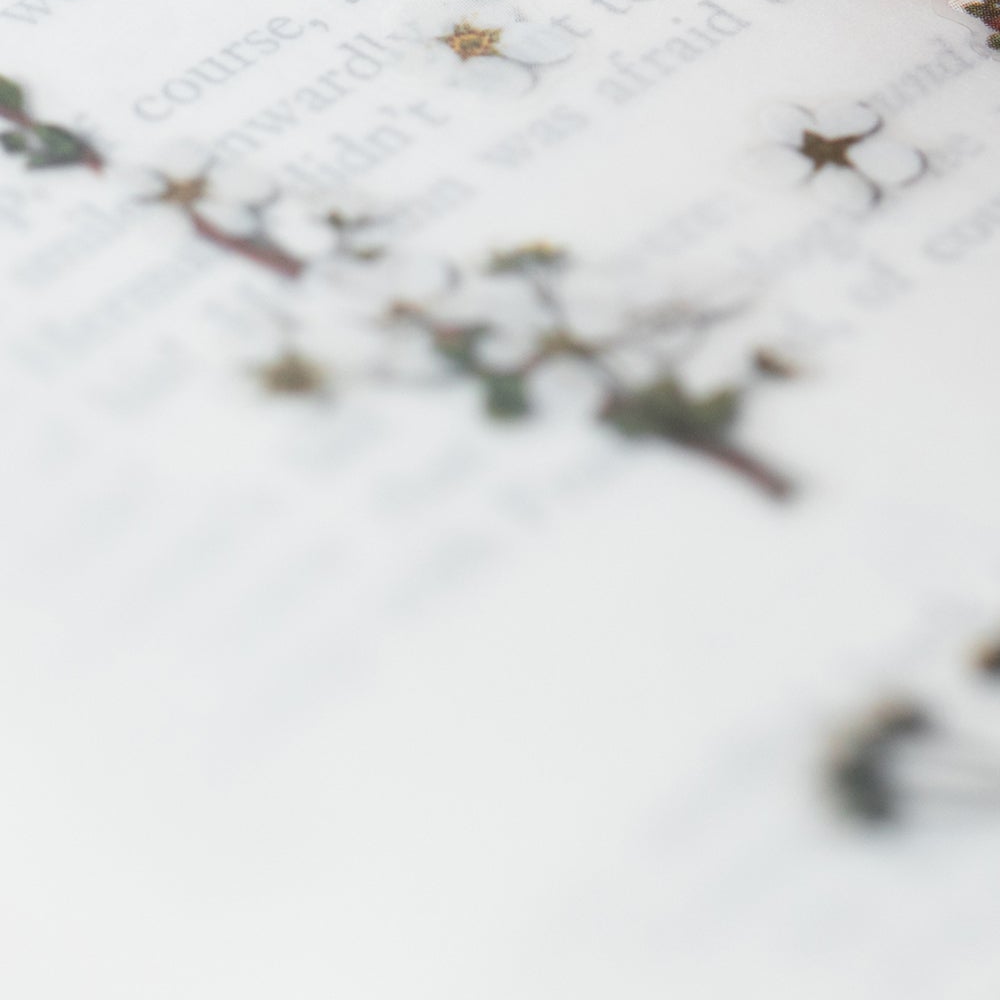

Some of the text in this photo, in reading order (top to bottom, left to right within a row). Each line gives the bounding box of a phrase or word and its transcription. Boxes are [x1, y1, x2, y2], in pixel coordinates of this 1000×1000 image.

[133, 15, 331, 121] course,
[212, 18, 437, 162] nwardly
[474, 104, 593, 171] was
